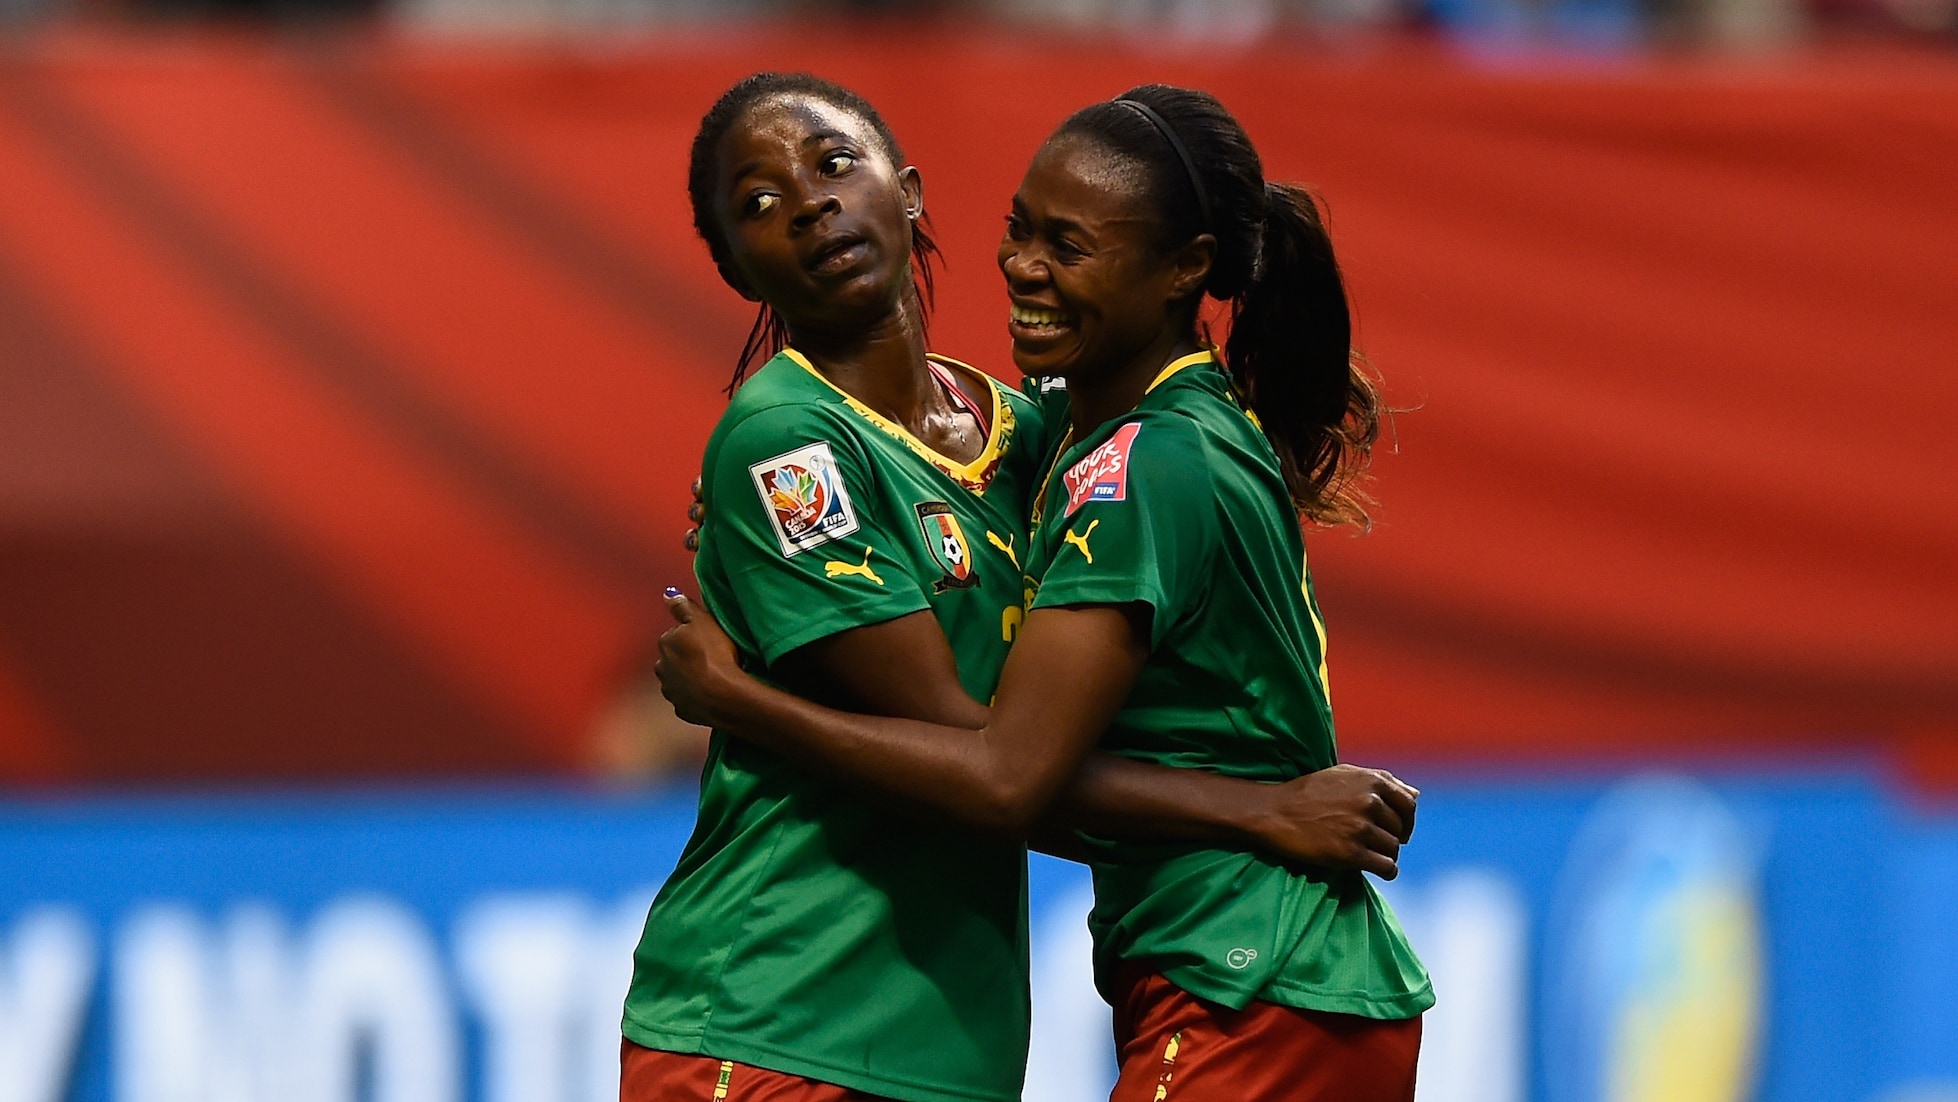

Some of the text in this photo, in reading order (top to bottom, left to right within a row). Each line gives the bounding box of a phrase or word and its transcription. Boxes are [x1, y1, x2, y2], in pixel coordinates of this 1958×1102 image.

[1068, 443, 1120, 485] YOUR
[1073, 455, 1122, 504] GOALS
[1094, 486, 1116, 495] FIFA
[785, 506, 817, 529] CANADA
[822, 512, 846, 527] FIFA
[789, 522, 806, 536] 2015
